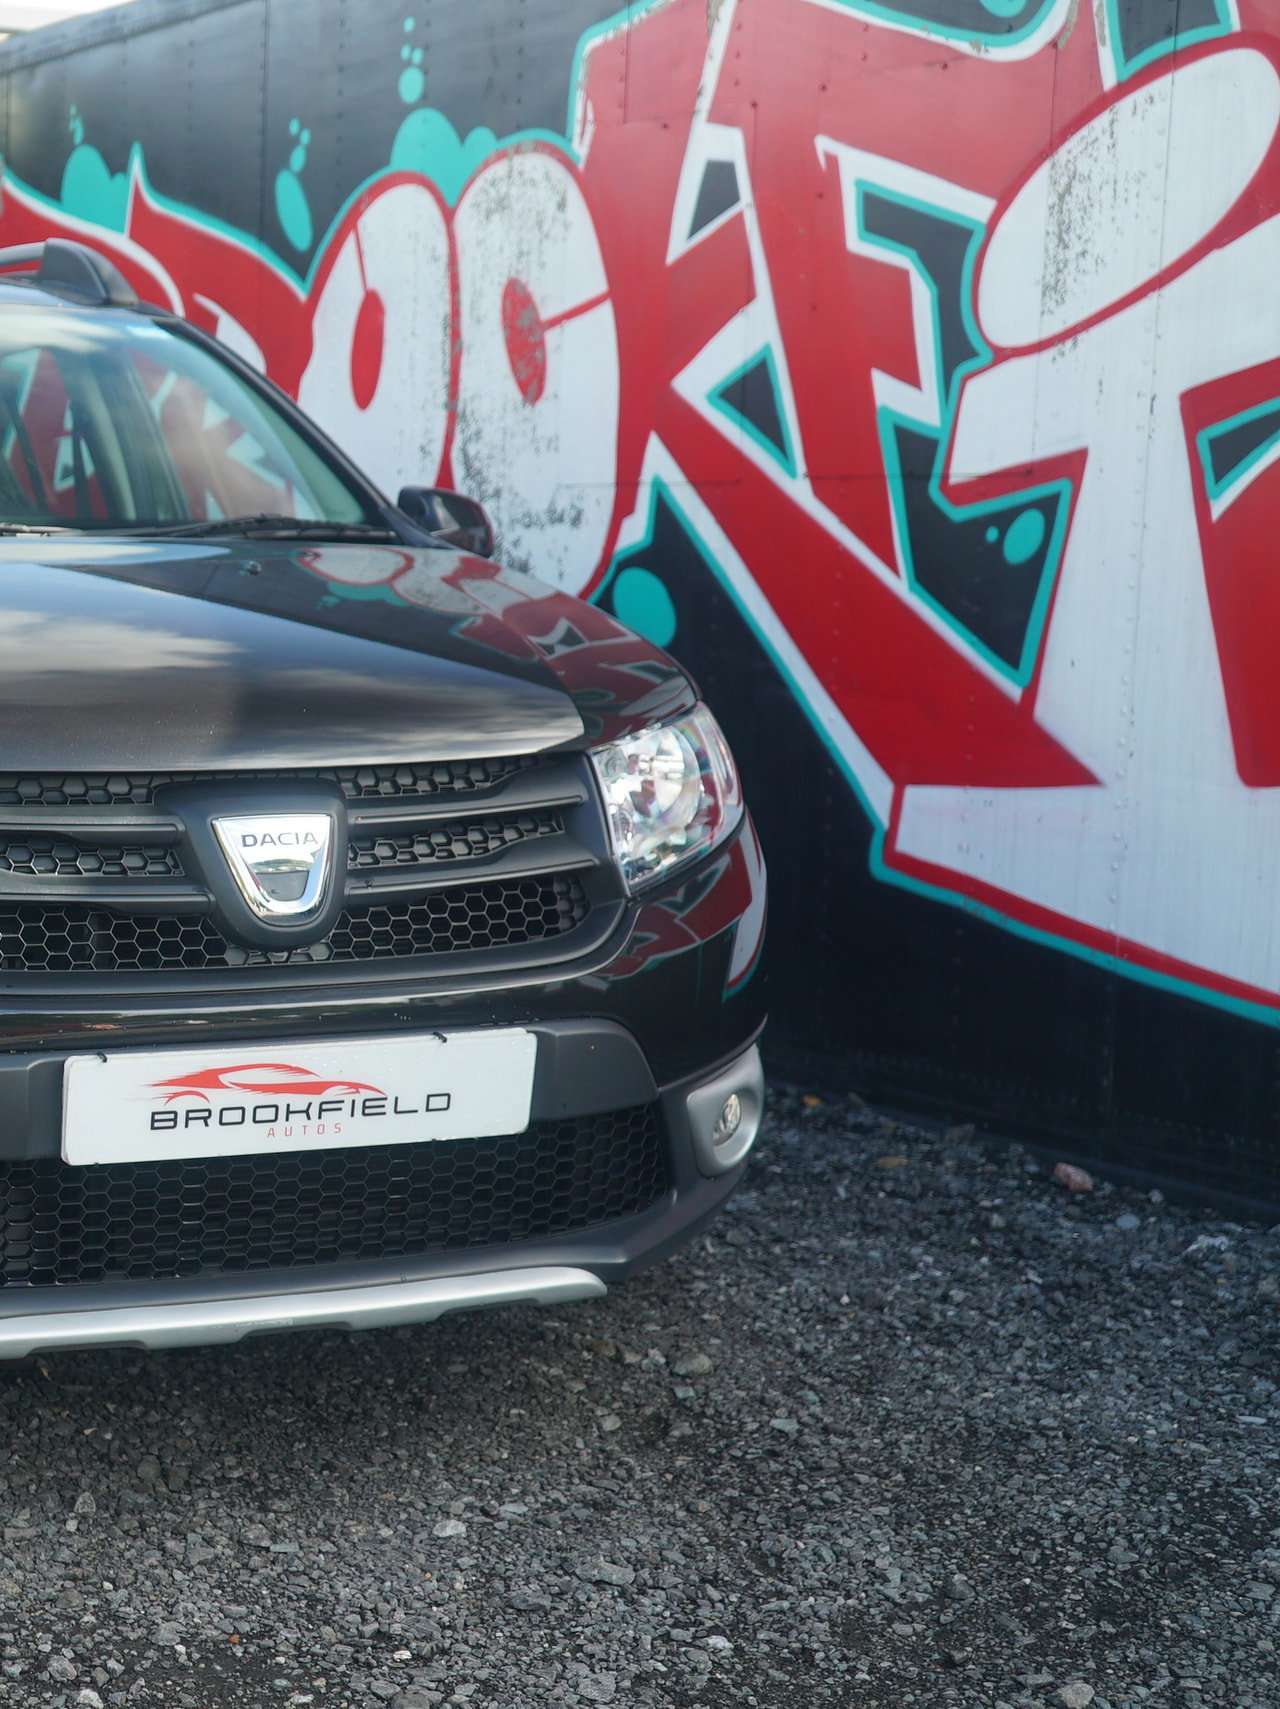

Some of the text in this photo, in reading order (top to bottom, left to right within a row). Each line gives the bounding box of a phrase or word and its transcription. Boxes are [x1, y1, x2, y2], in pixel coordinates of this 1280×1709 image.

[240, 831, 320, 848] DACIA
[150, 1092, 452, 1131] BROOKFIELD
[266, 1122, 343, 1139] AUTOS
